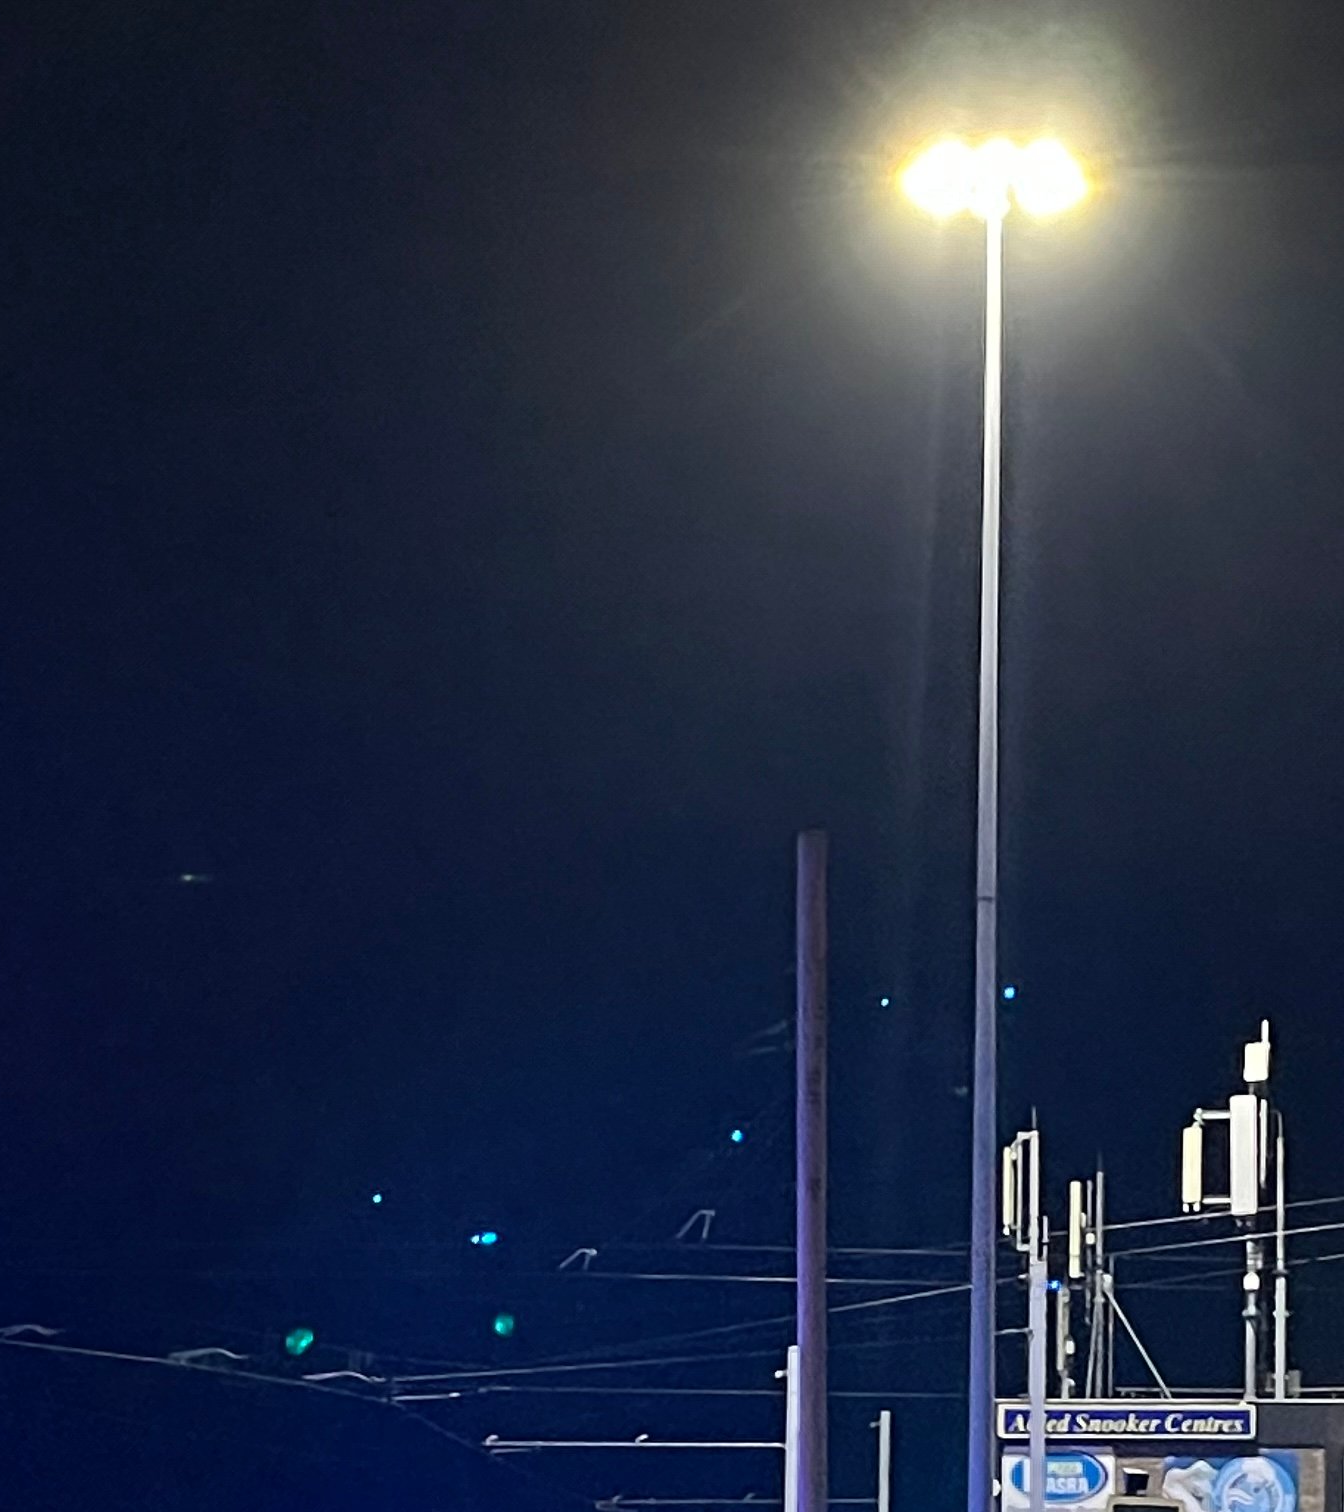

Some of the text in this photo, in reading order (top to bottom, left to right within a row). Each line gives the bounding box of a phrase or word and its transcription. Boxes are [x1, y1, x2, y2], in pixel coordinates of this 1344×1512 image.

[1008, 1413, 1244, 1434] Aed Snooker Centres
